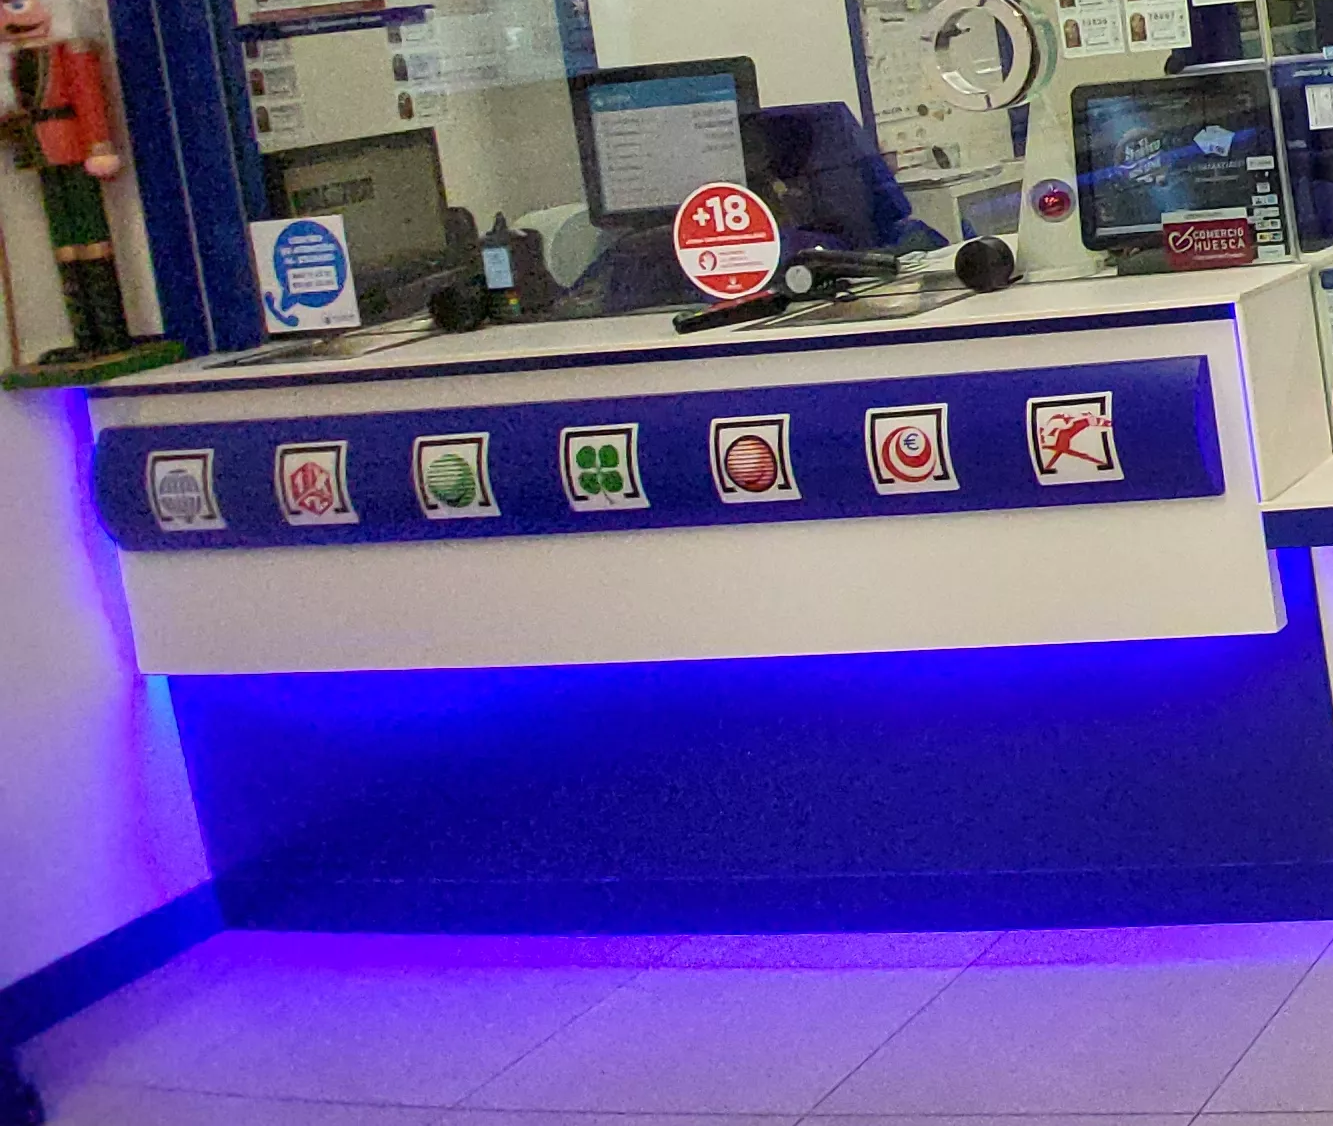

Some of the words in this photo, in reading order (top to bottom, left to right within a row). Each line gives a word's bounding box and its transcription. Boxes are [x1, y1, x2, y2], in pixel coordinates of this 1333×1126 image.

[692, 194, 751, 232] +18
[1193, 226, 1245, 240] COMERCIO
[1194, 238, 1246, 252] HUESCA
